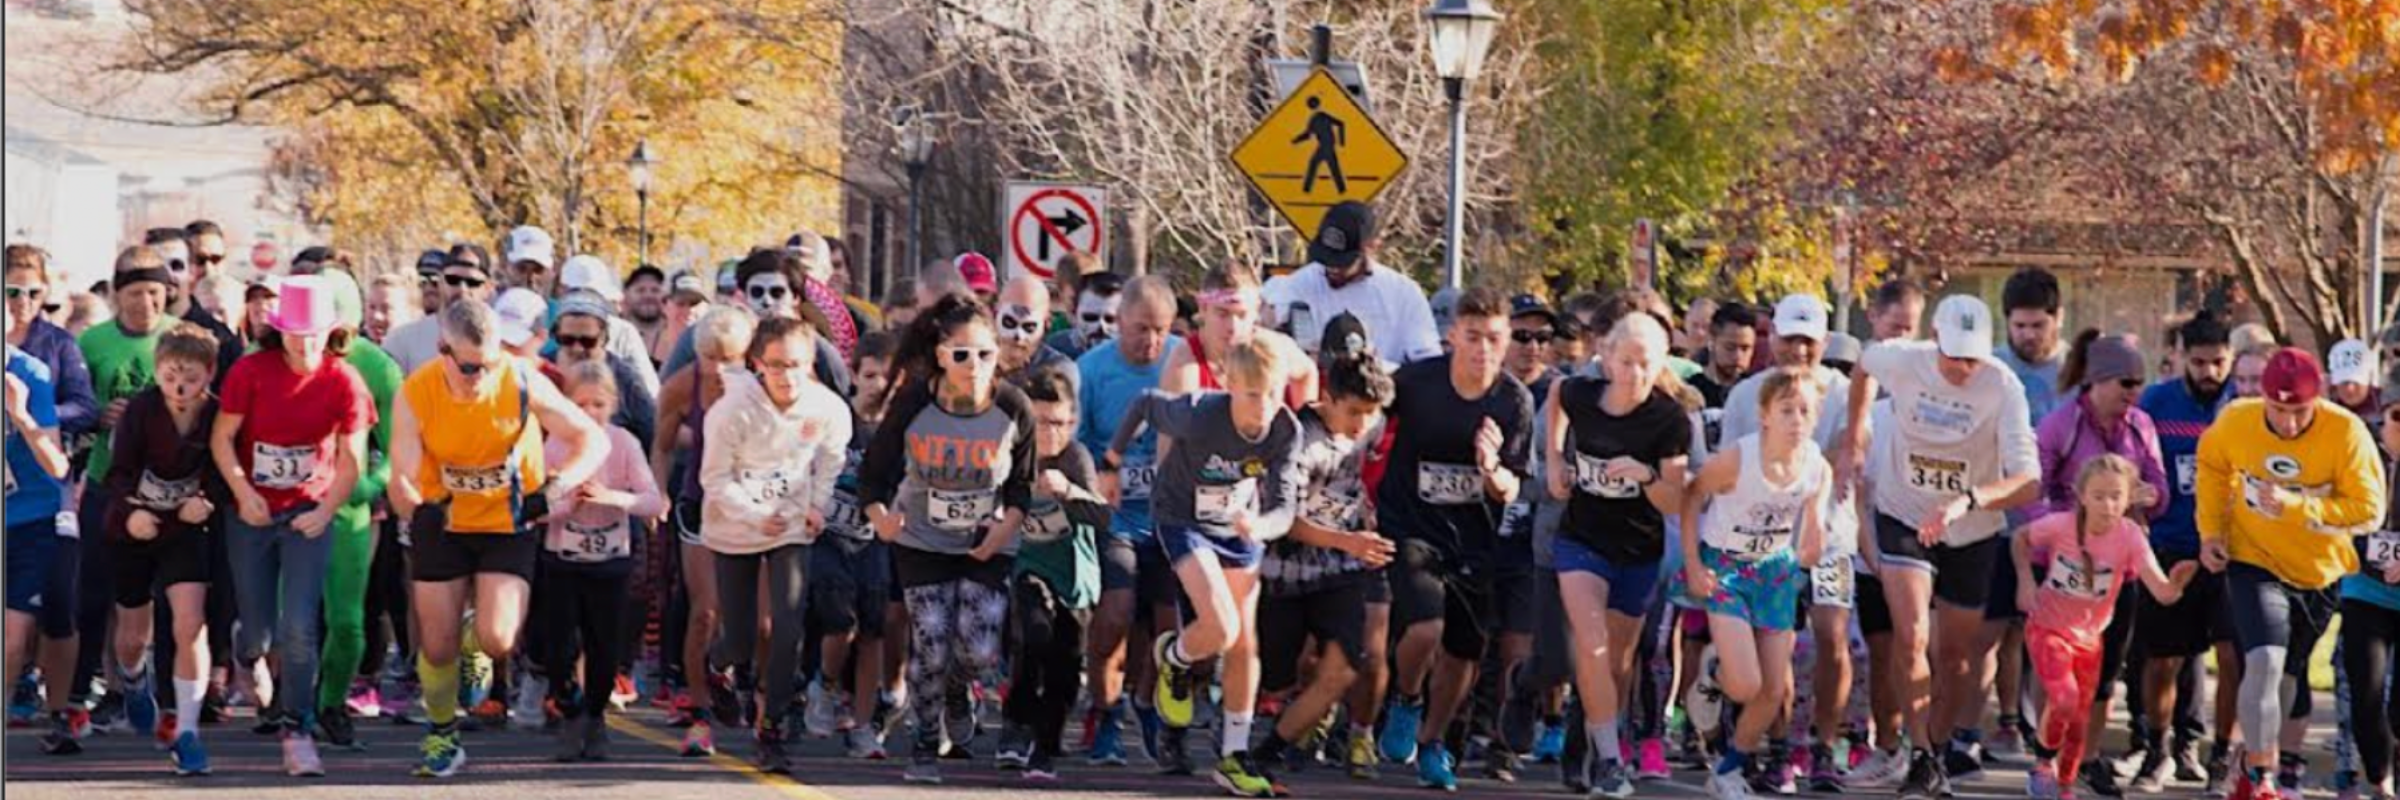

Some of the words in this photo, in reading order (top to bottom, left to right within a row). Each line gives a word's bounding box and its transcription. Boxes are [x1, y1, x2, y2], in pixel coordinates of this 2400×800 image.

[272, 458, 299, 478] 31
[450, 476, 504, 490] 333
[1429, 475, 1474, 494] 230
[1911, 466, 1963, 492] 346
[761, 479, 789, 500] 63
[947, 501, 976, 519] 62
[1021, 517, 1049, 534] 61
[578, 534, 607, 553] 49
[1744, 536, 1774, 553] 40
